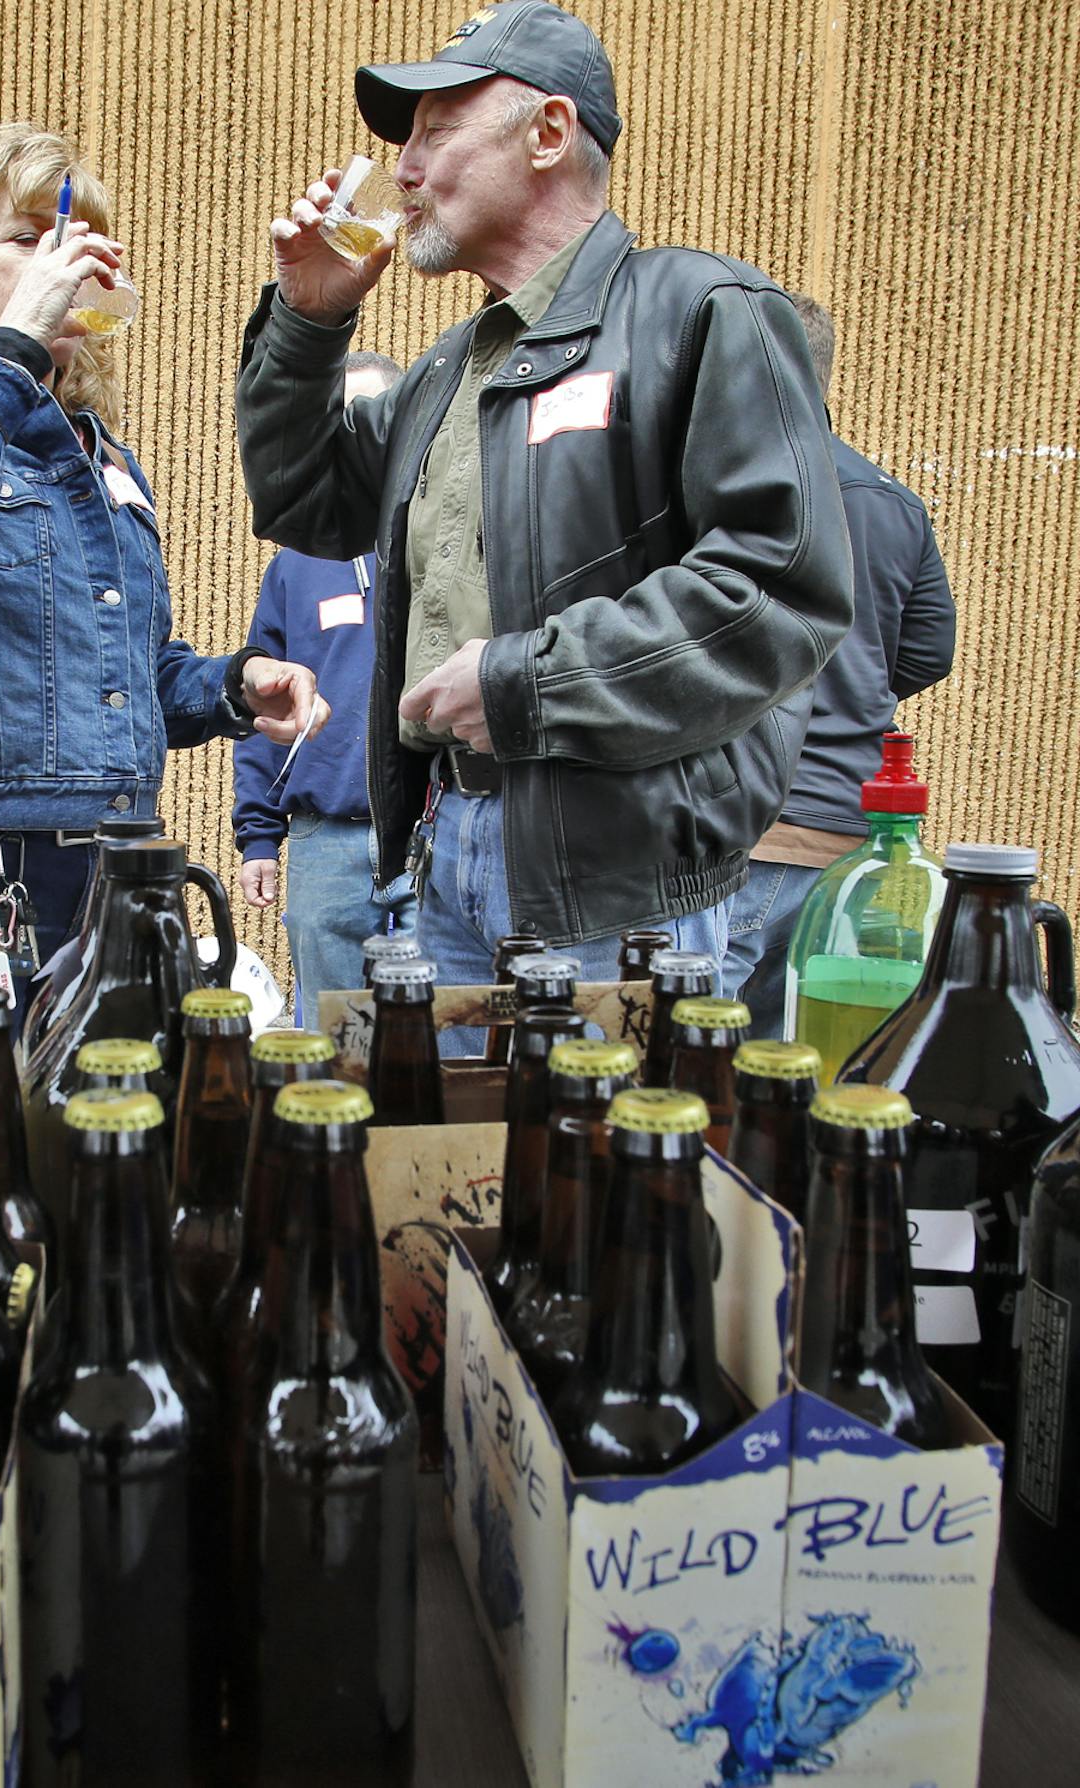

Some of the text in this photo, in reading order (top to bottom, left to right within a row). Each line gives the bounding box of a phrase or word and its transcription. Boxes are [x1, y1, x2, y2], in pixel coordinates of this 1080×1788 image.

[492, 1377, 547, 1519] BLUE
[585, 1483, 993, 1596] WILD BLUE
